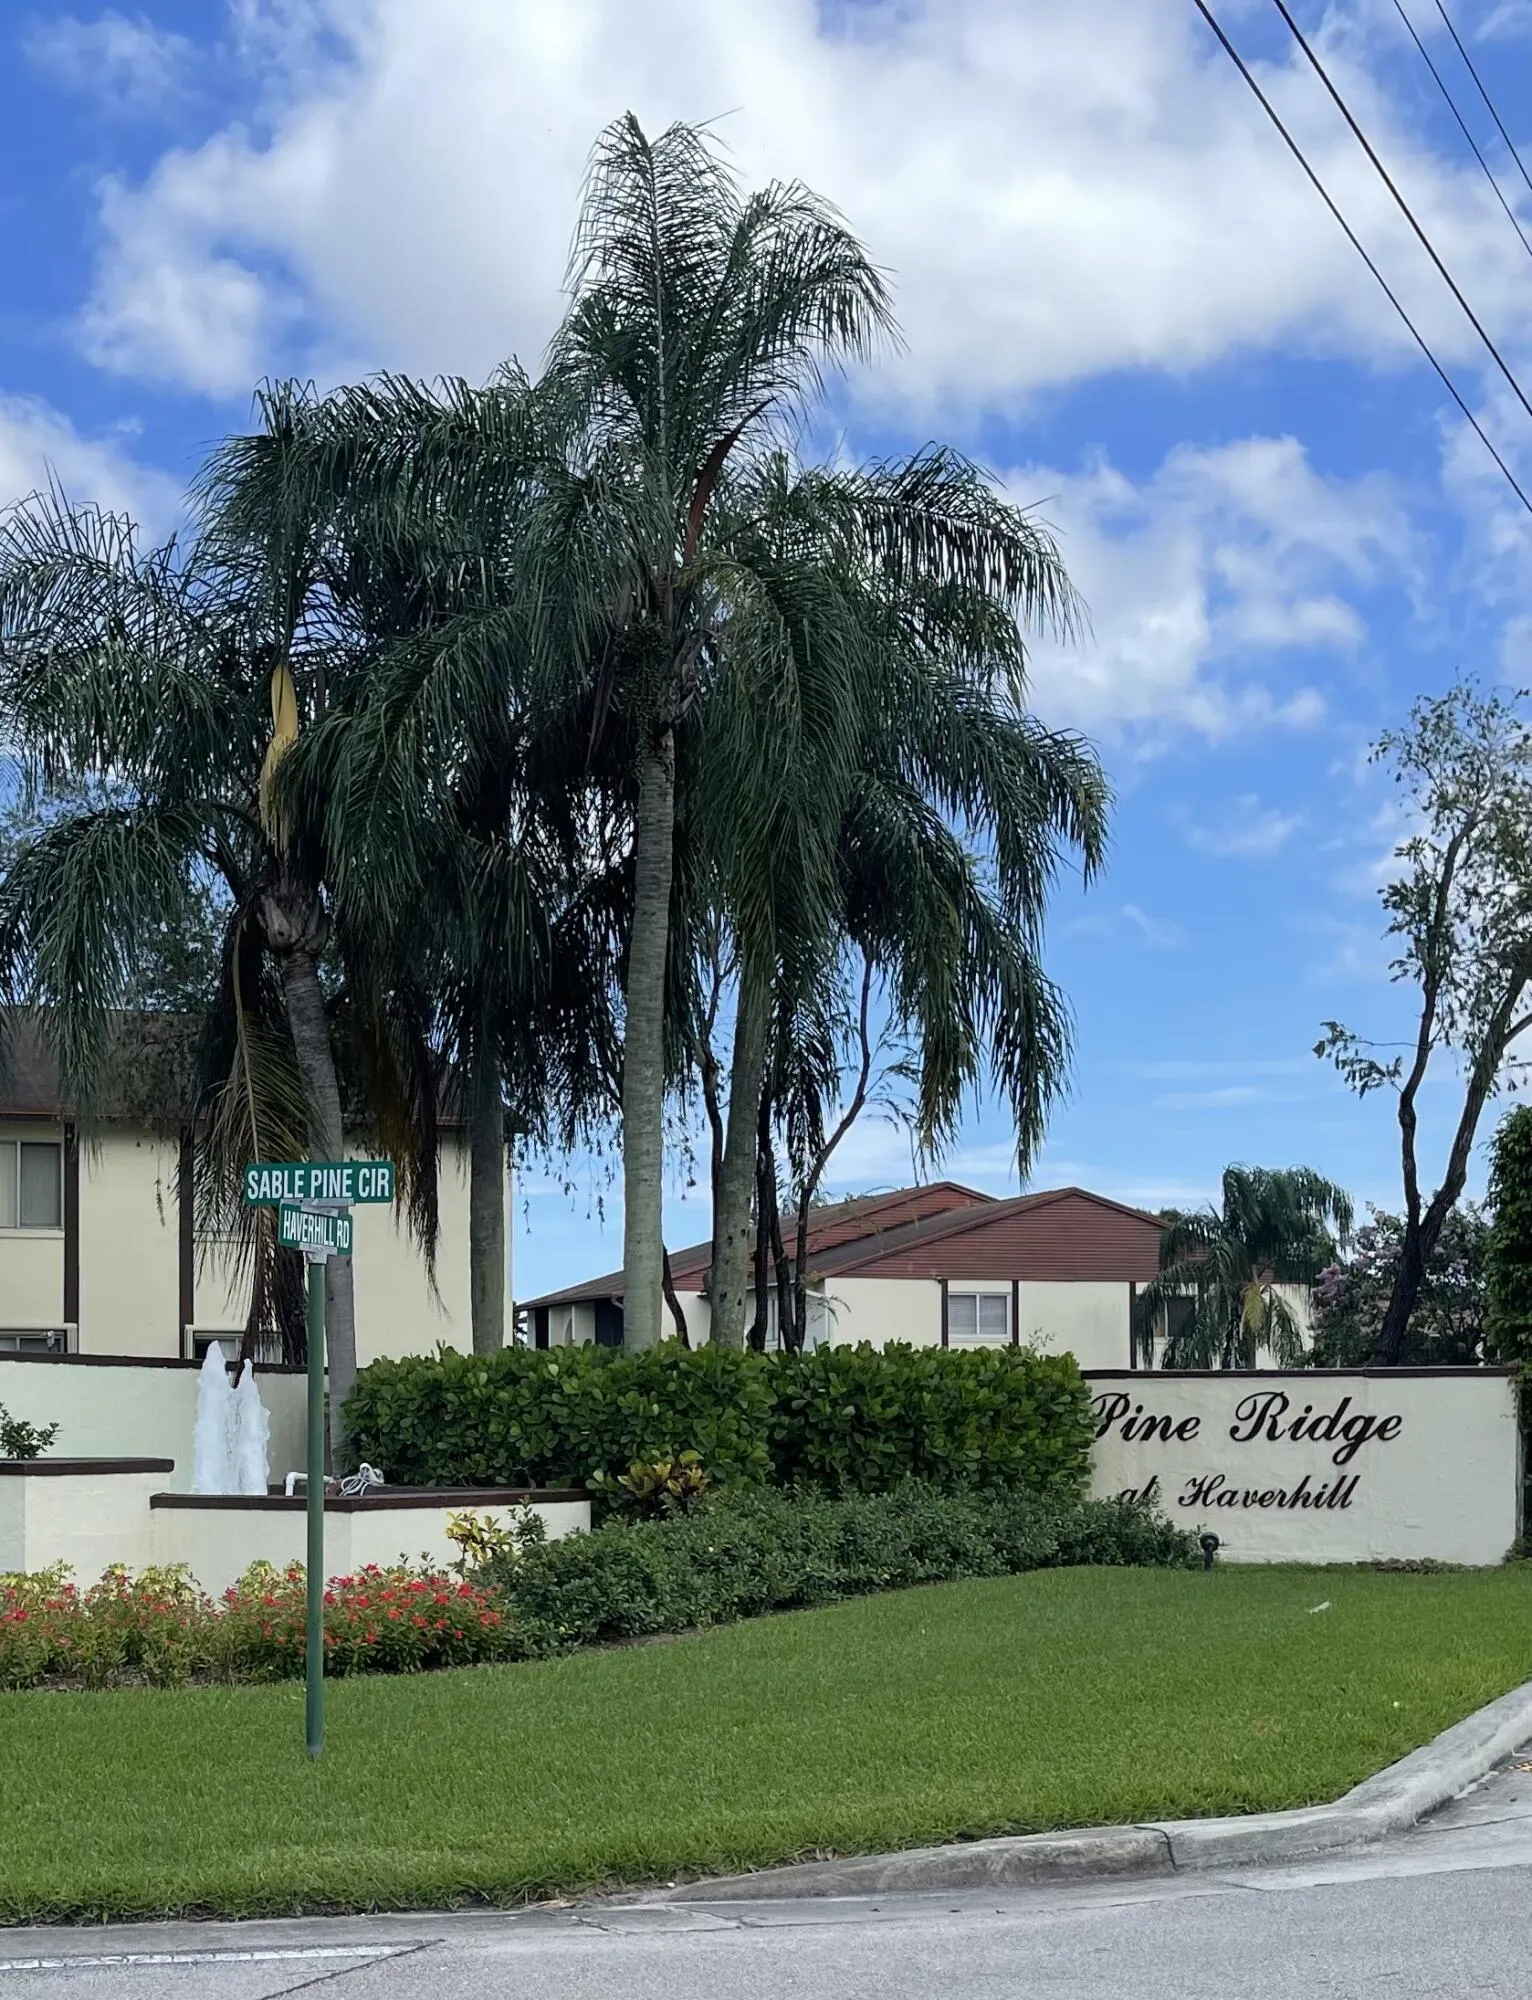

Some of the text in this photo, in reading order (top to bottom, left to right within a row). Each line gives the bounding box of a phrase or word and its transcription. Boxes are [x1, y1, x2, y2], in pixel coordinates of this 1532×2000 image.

[247, 1167, 389, 1199] SABLE PINE CIR
[283, 1209, 350, 1249] HAVERHILL RD
[1091, 1391, 1402, 1466] Pine Ridge
[1178, 1474, 1360, 1509] Haverhill
